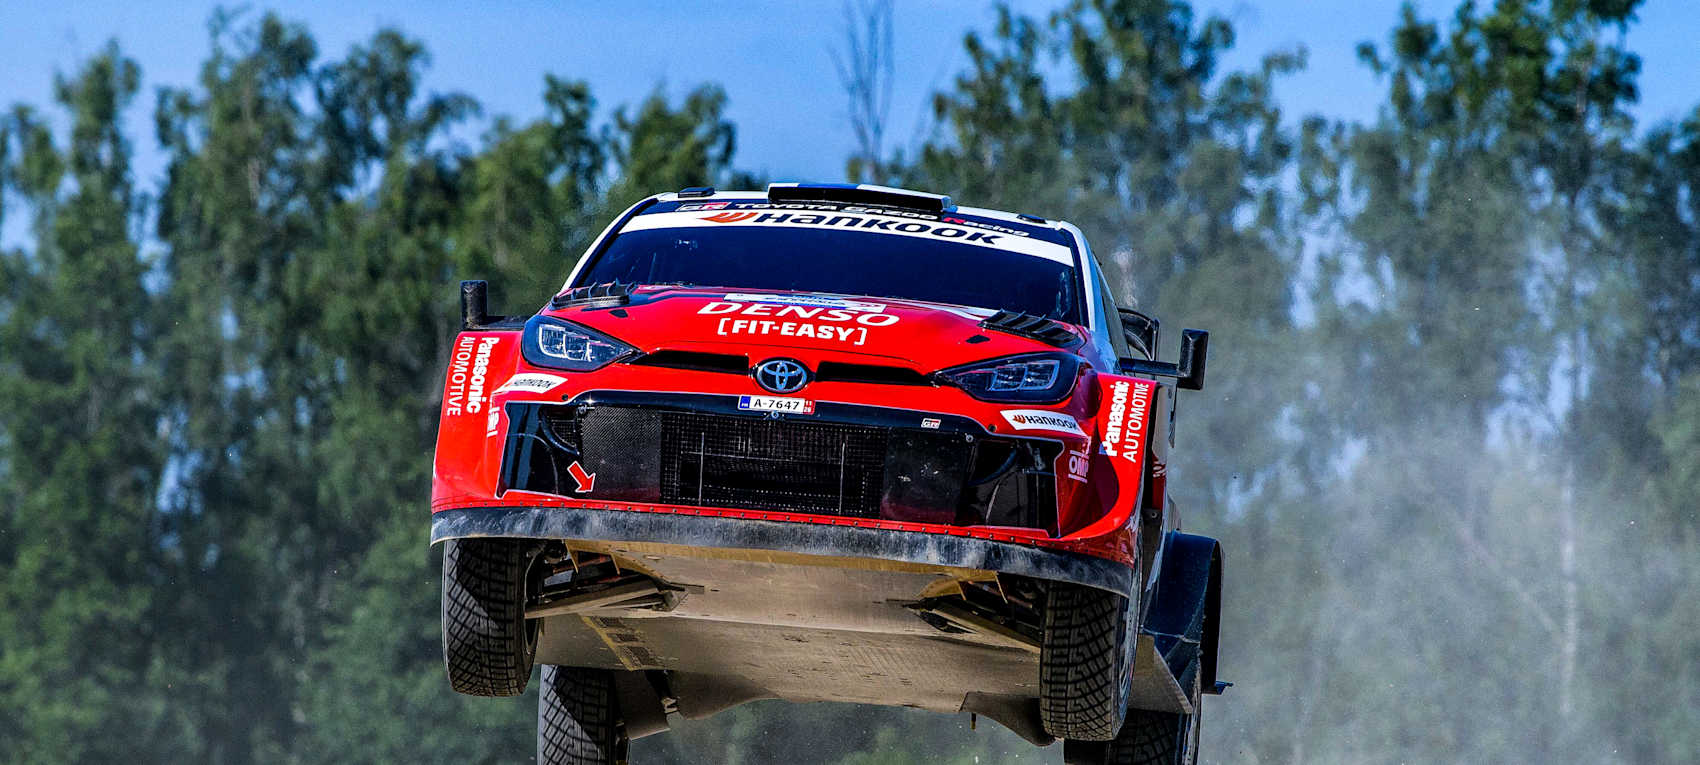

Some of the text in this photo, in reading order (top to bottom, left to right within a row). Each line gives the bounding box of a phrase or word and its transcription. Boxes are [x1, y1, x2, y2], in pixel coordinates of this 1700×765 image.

[840, 205, 938, 220] GAZOO
[943, 217, 1030, 237] Racing
[697, 302, 900, 326] DENSO
[447, 336, 475, 416] AUTOMOTIVE
[466, 337, 500, 413] Panasonic
[754, 398, 800, 410] A-7647
[1102, 380, 1130, 457] Panasonic
[1123, 382, 1149, 463] AUTOMOTIVE
[1068, 455, 1088, 478] OMP
